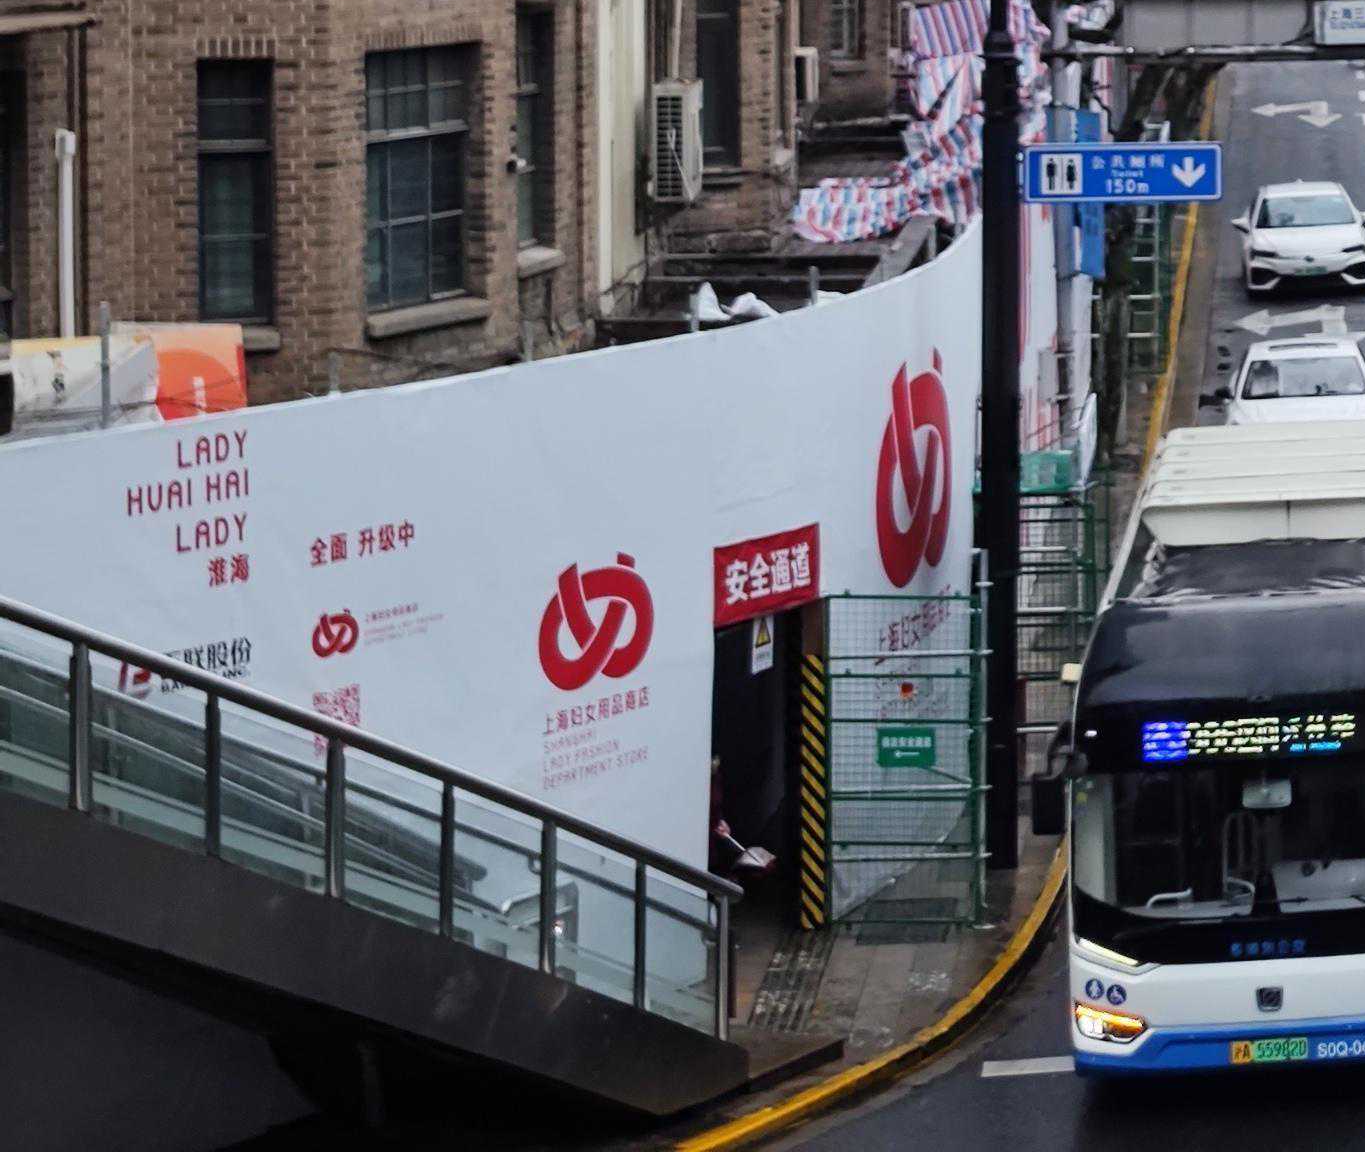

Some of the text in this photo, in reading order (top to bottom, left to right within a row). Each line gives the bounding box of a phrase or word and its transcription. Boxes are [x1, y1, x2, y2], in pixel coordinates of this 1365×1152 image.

[1105, 178, 1149, 194] 150m
[177, 429, 247, 469] LADY
[126, 468, 249, 517] HUAI HAI
[176, 512, 247, 553] LADY
[310, 519, 415, 567] 全面 升级中
[208, 553, 249, 587] 淮海
[725, 541, 811, 605] 安全通道
[165, 635, 251, 671] 联股份
